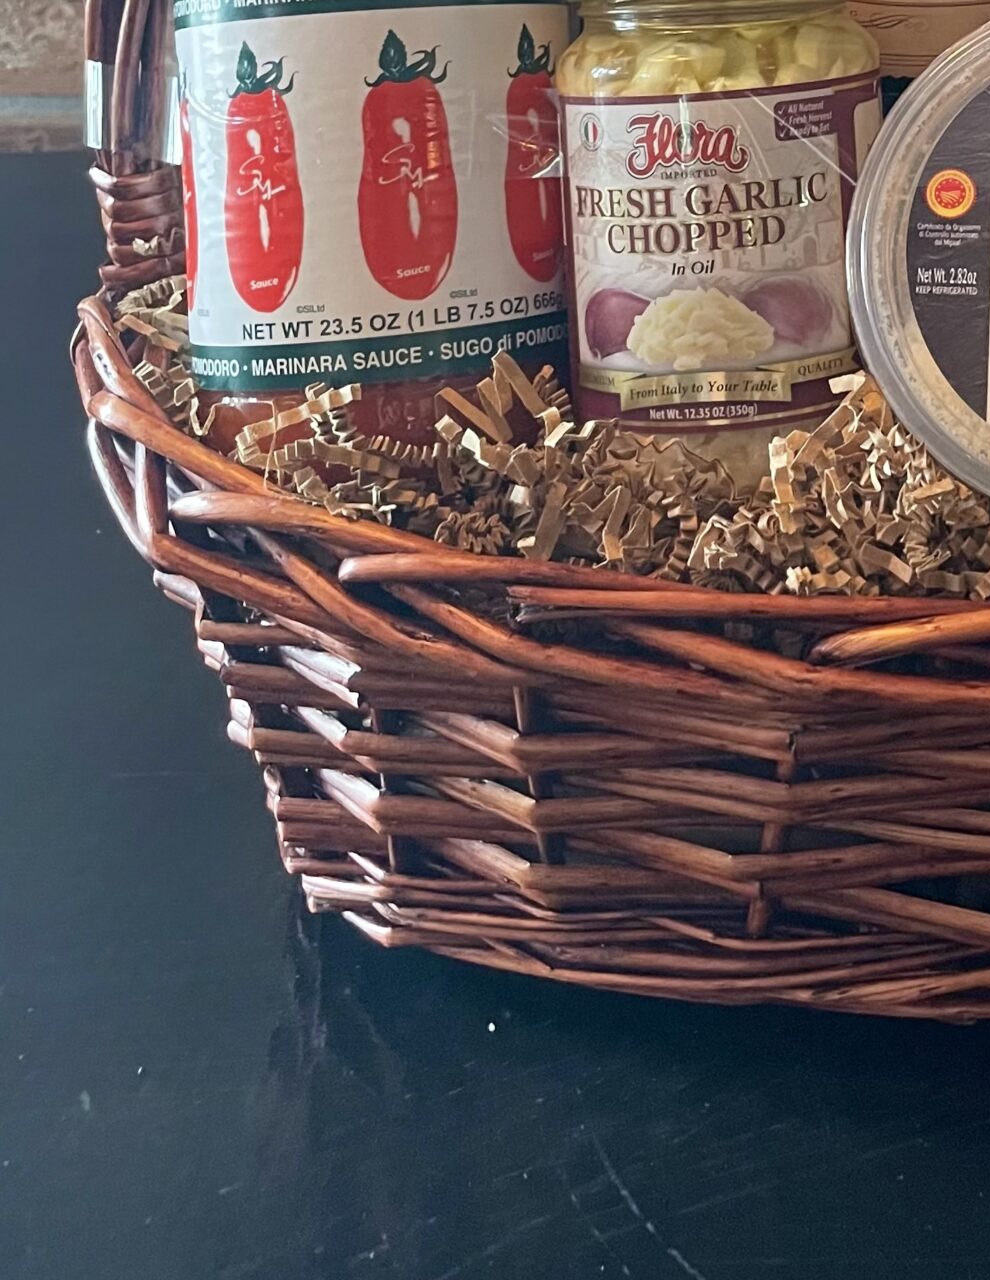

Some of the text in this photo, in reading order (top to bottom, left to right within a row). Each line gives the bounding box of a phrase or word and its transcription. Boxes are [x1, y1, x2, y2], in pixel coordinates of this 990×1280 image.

[625, 112, 751, 180] Flora
[660, 168, 718, 180] IMPORTED
[575, 171, 829, 219] FRESH GARLIC
[607, 215, 786, 254] CHOPPED
[396, 264, 431, 278] Sauce
[671, 260, 715, 276] In Oil
[917, 267, 932, 283] Net
[250, 278, 279, 290] Sauce
[915, 286, 932, 294] KEEP
[242, 323, 276, 341] NET
[281, 320, 313, 339] WT
[320, 314, 363, 336] 23.5
[369, 313, 400, 333] OZ
[407, 310, 425, 333] (1
[433, 306, 462, 326] LB
[467, 301, 495, 320] 7.5
[500, 296, 529, 316] OZ)
[251, 353, 346, 377] MARINARA
[353, 347, 423, 370] SAUCE
[440, 336, 493, 362] SUGO
[498, 333, 512, 352] di
[797, 357, 844, 377] QUALITY
[629, 379, 779, 401] From Italy to Your Table
[649, 408, 665, 420] Net
[684, 407, 711, 419] 12.35
[712, 406, 726, 418] OZ
[726, 402, 758, 418] (350g)
